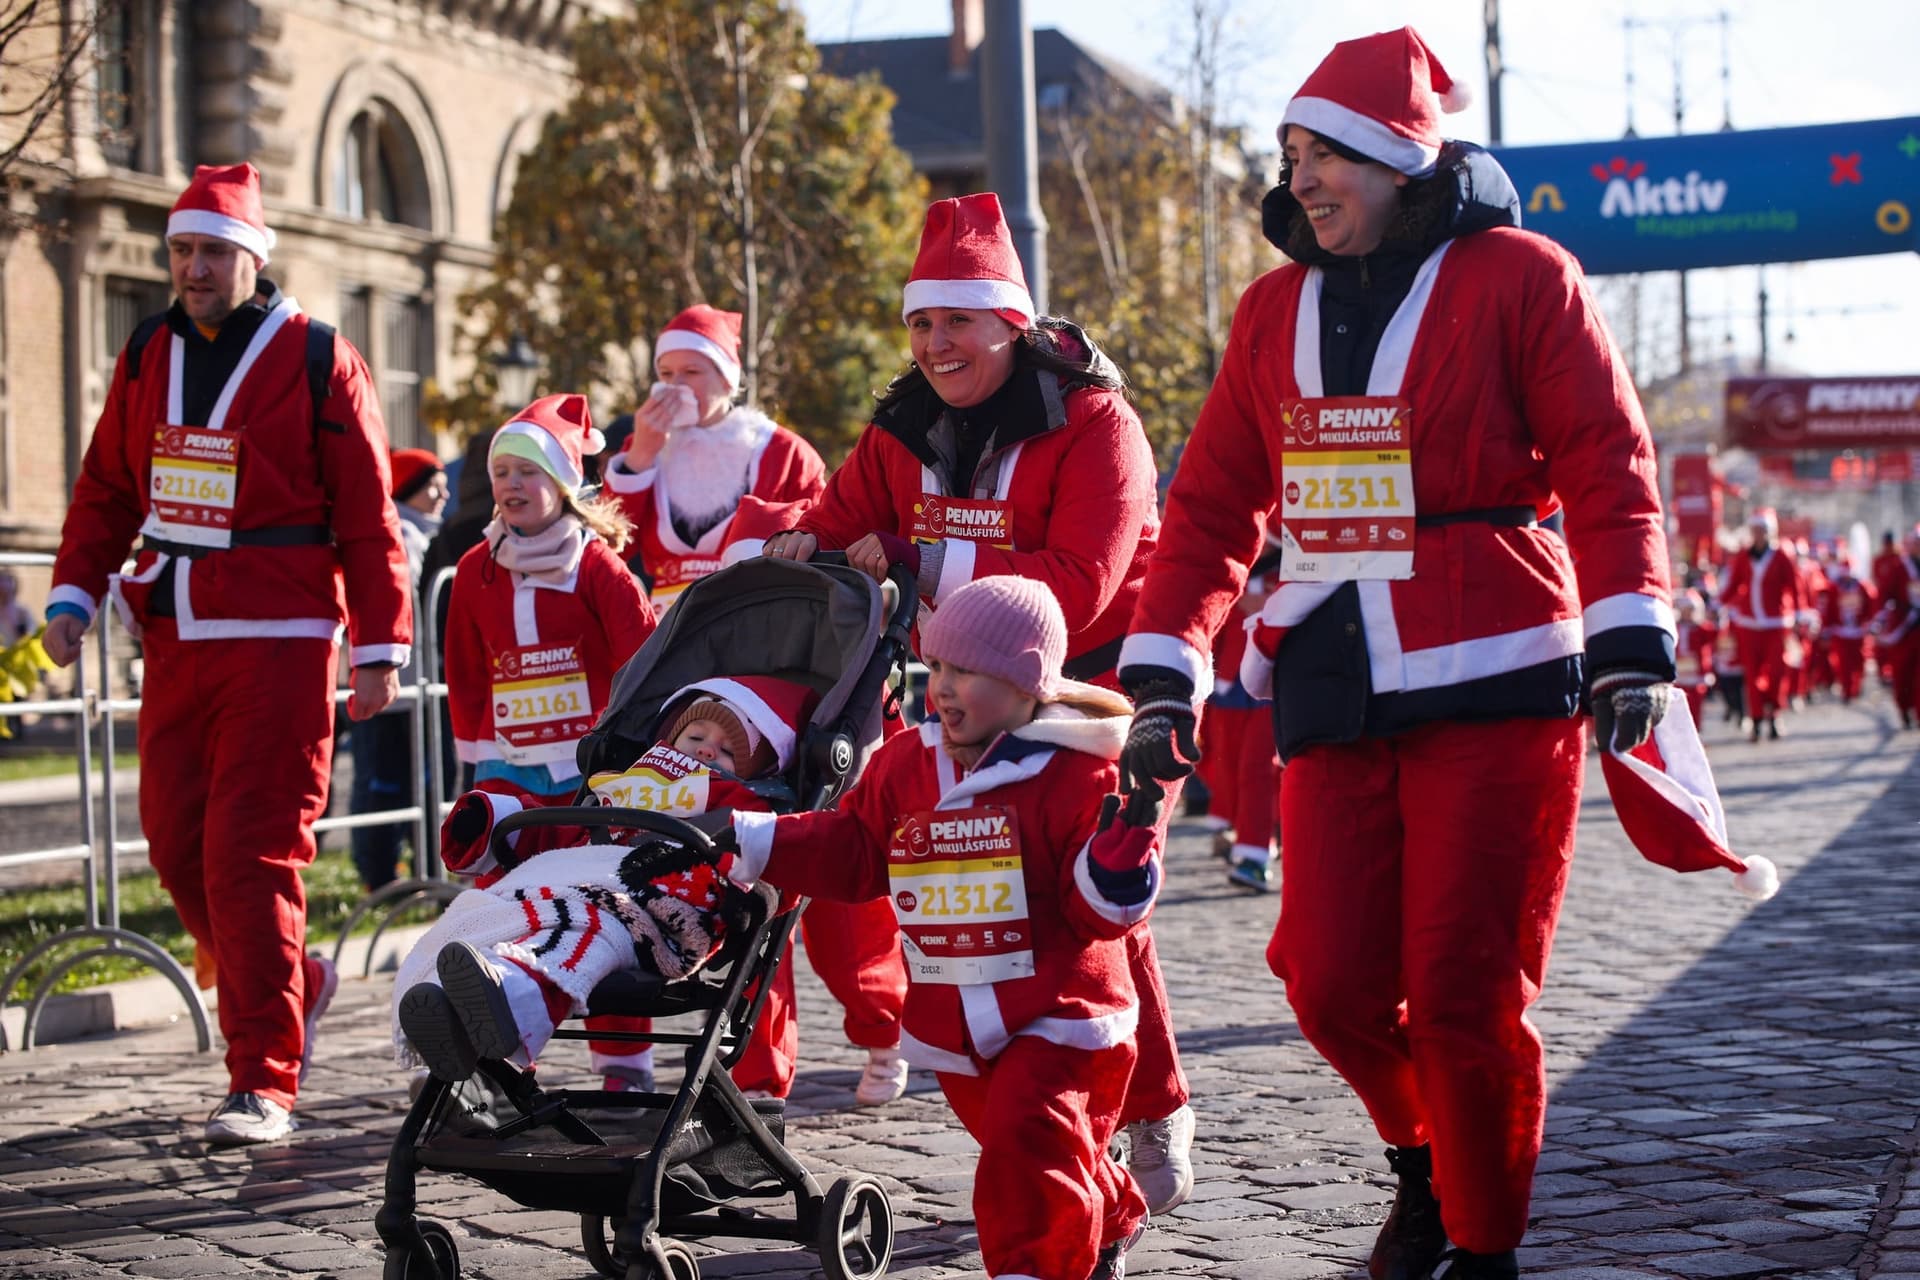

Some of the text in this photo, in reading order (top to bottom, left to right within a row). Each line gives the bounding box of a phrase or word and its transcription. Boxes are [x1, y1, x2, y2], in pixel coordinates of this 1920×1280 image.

[1319, 430, 1401, 444] MIKULÁSFUTÁS
[163, 475, 228, 501] 21164
[1304, 476, 1401, 509] 21311
[945, 525, 1006, 538] MIKULÁSFUTÁS
[522, 661, 579, 676] MIKULÁSFUTÁS
[511, 691, 582, 720] 21161
[933, 838, 1011, 854] MIKULÁSFUTÁS
[920, 882, 1014, 916] 21312
